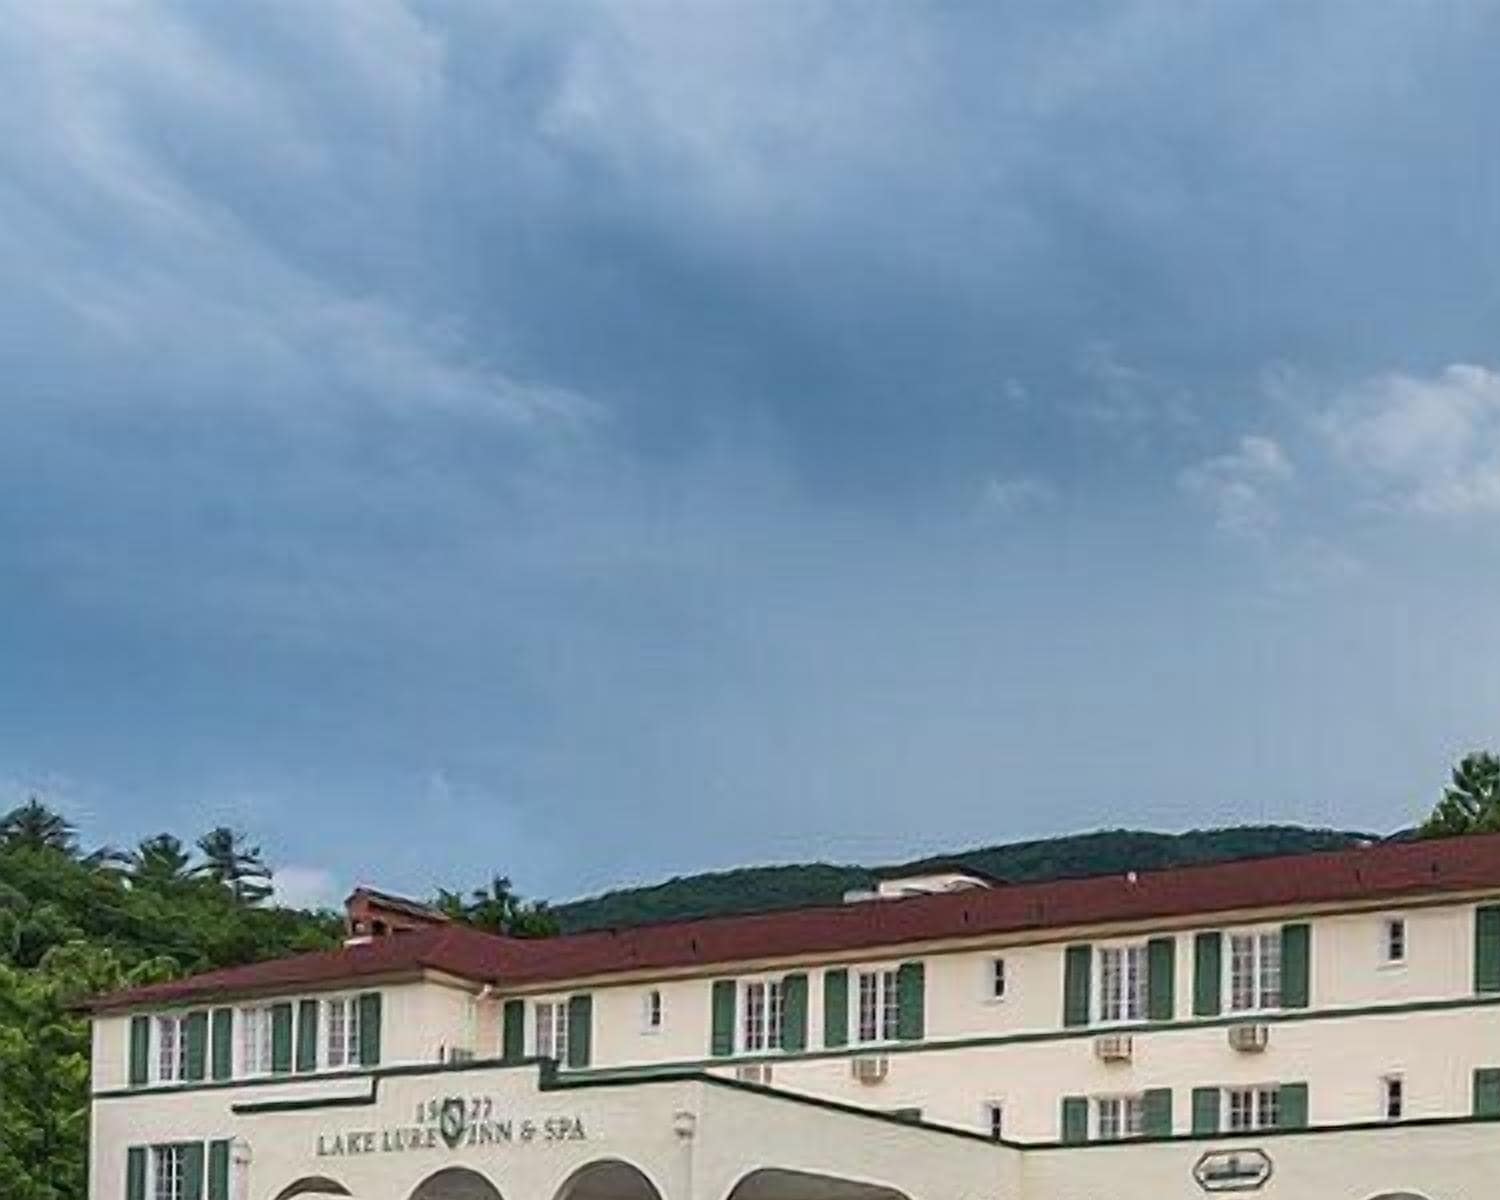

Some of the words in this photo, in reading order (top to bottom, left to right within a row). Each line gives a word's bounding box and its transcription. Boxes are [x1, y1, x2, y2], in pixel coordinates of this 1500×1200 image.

[317, 1131, 376, 1156] LAKE
[467, 1119, 513, 1144] INN
[545, 1117, 587, 1141] SPA
